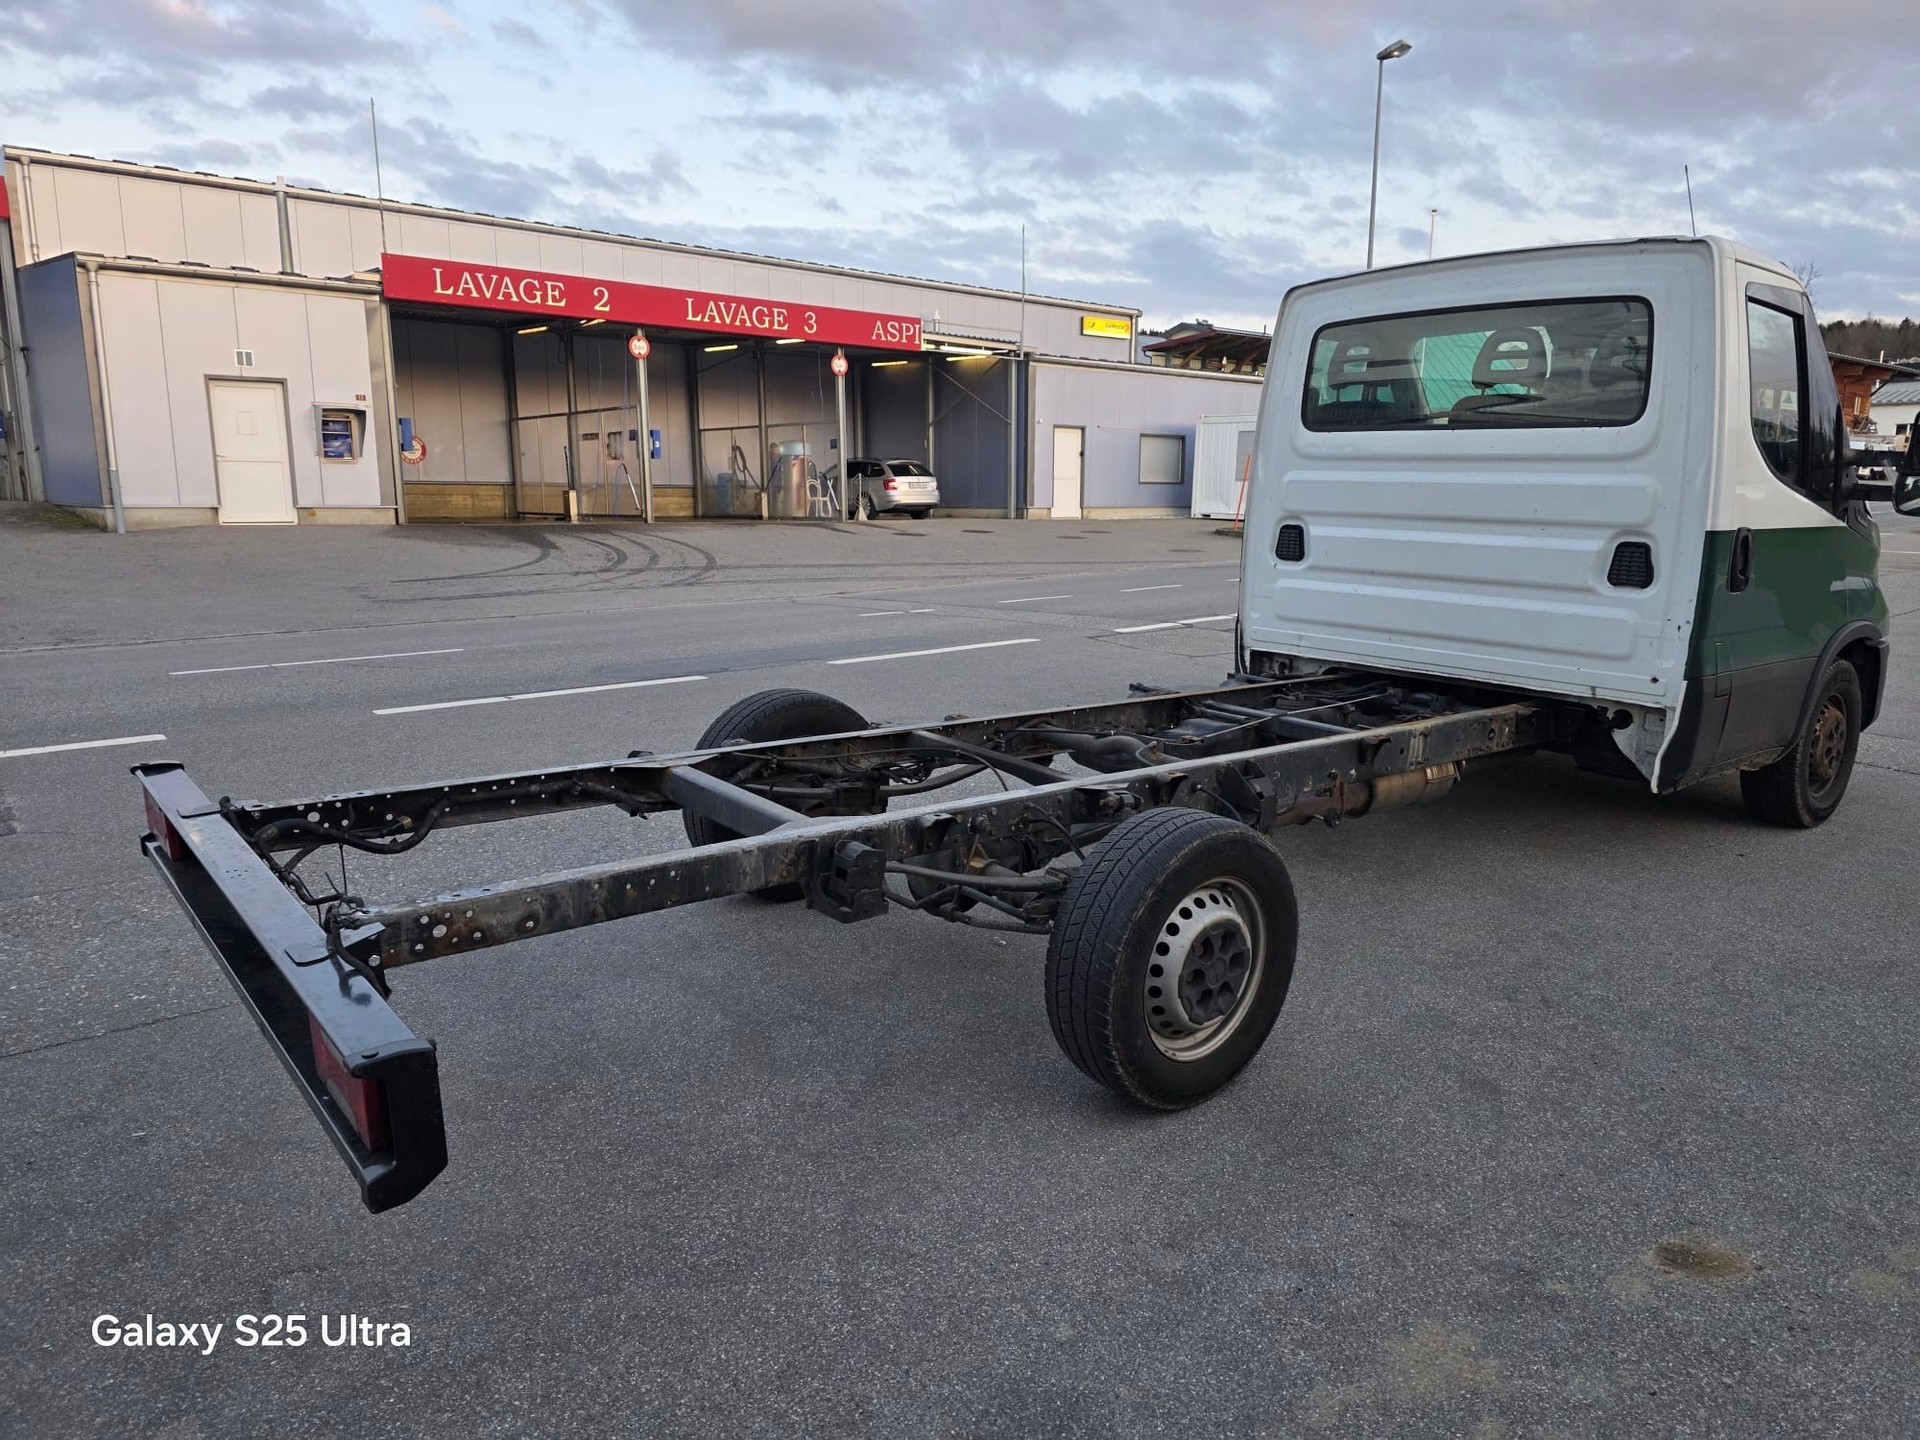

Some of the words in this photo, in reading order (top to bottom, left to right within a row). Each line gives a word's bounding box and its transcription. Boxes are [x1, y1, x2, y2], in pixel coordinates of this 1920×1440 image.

[432, 267, 567, 307] LAVAGE
[593, 286, 611, 312] 2
[685, 297, 789, 331] LAVAGE
[803, 311, 818, 334] 3
[871, 320, 921, 345] ASPI
